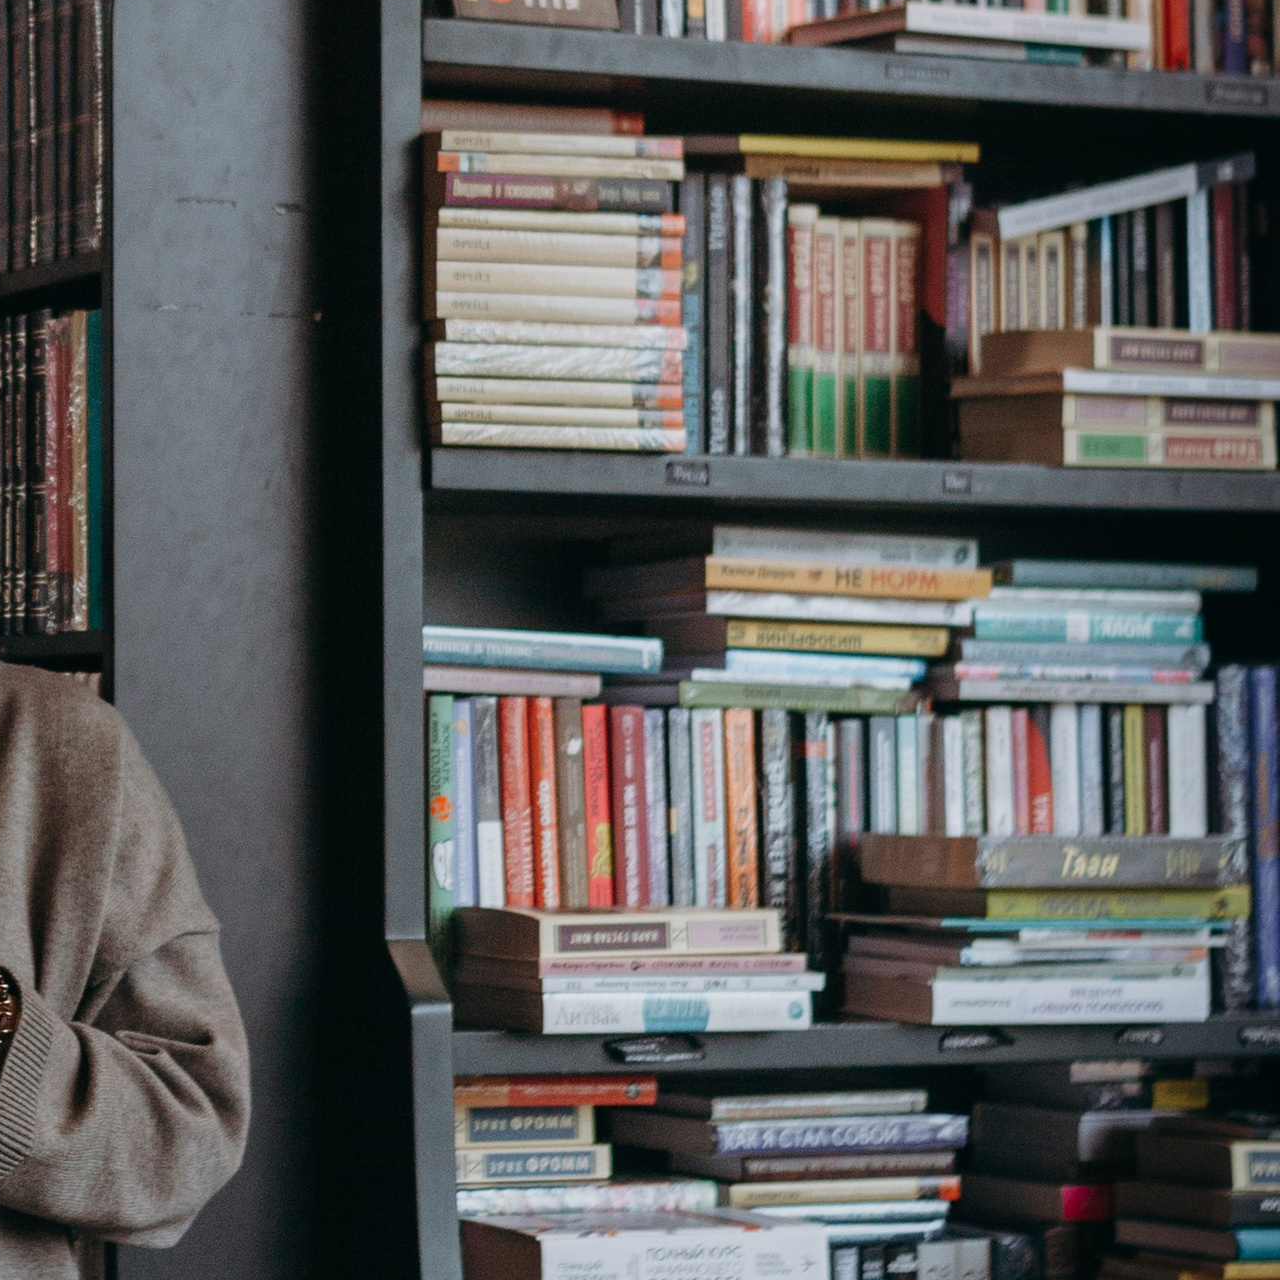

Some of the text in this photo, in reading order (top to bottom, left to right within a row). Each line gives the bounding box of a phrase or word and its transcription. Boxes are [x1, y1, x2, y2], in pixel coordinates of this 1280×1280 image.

[835, 566, 939, 591] НЕ НОРМ
[538, 778, 551, 826] ОДНО
[509, 1114, 574, 1131] ФРОММ
[525, 1154, 591, 1173] ФРОММ
[645, 1243, 706, 1261] ПОЛНЫЙ
